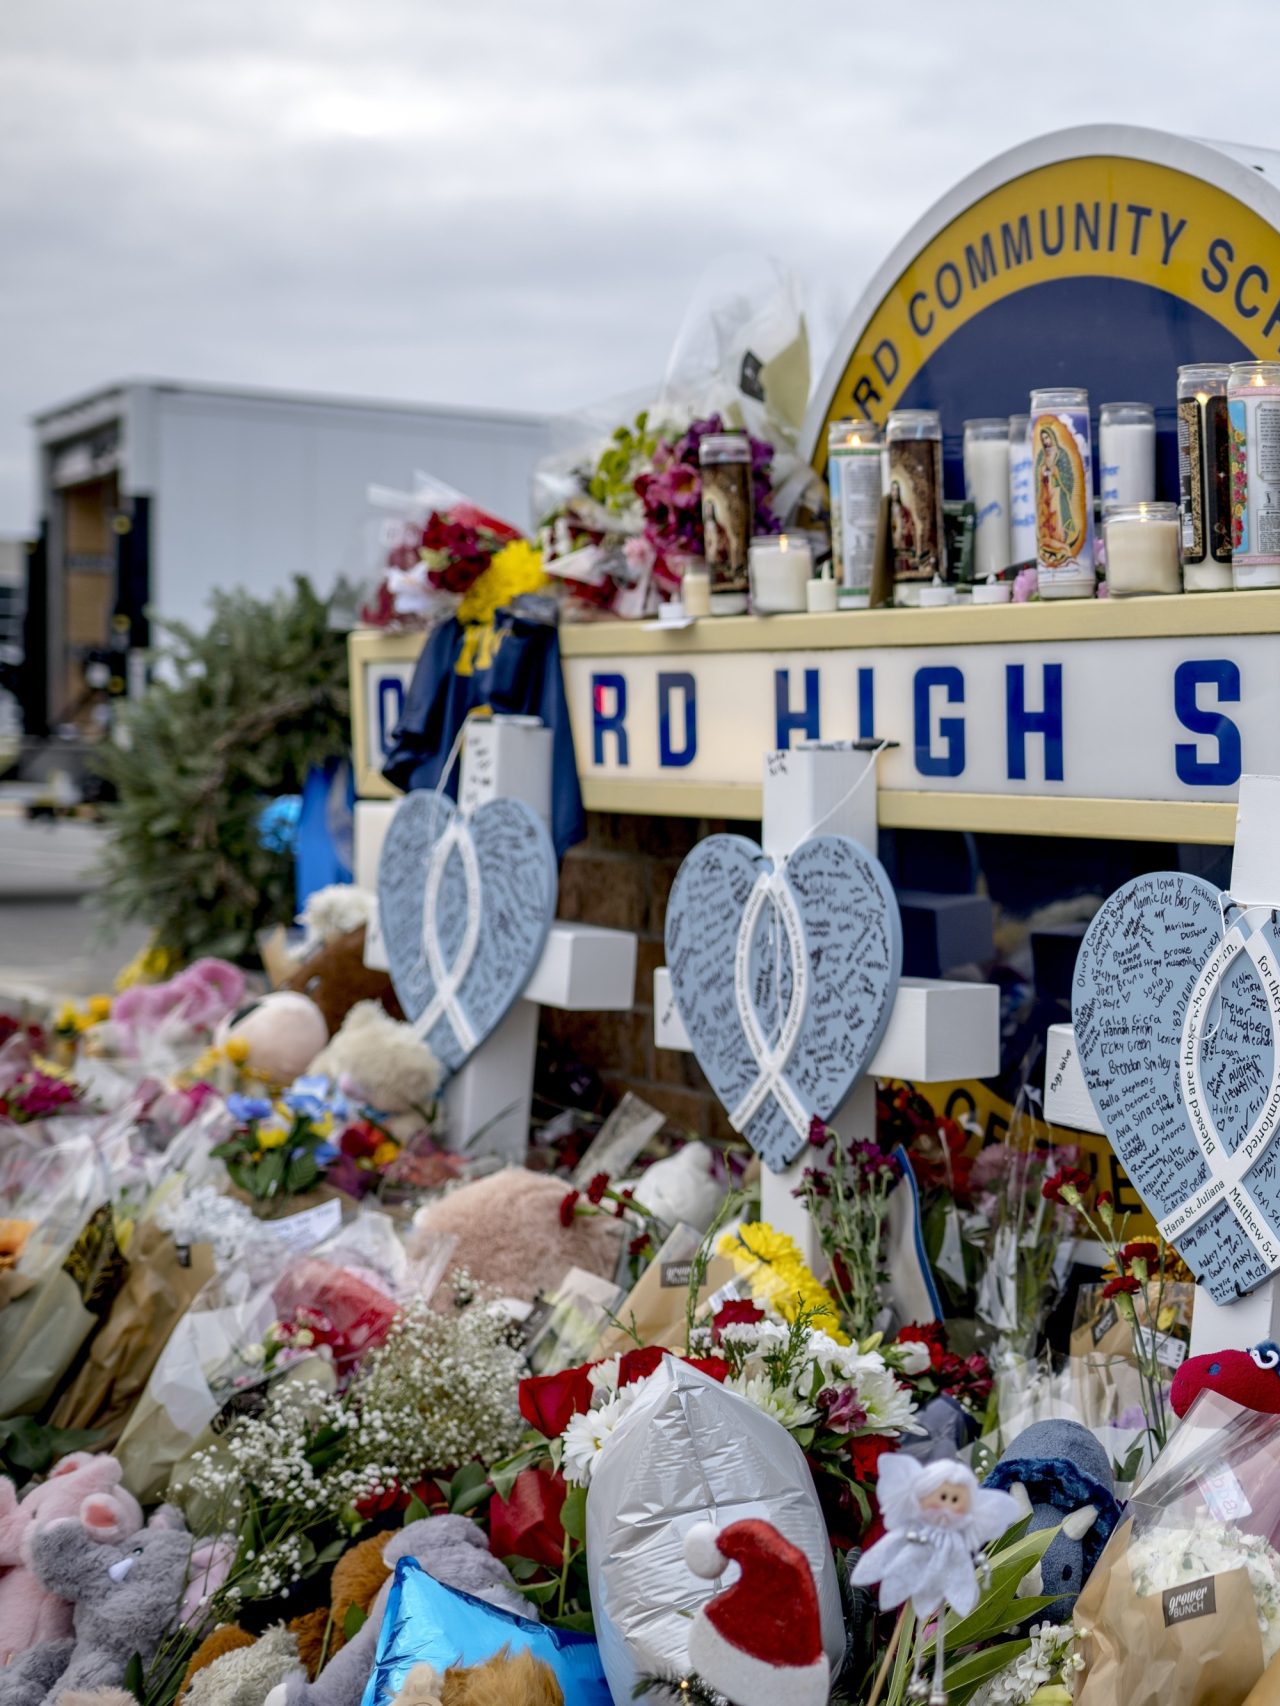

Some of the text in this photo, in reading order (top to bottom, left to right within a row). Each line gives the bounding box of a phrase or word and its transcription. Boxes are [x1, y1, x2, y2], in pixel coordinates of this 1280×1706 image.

[907, 202, 1188, 337] COMMUNITY
[774, 663, 1065, 781] HIGH
[1086, 901, 1114, 947] Cameron
[1163, 946, 1192, 959] Brooke
[1194, 931, 1221, 973] Dorsey
[1257, 955, 1272, 978] for
[1143, 979, 1163, 998] Sofia
[1152, 977, 1174, 1008] Jacob
[1221, 996, 1251, 1017] Trevor
[1103, 1025, 1130, 1038] Hannah
[1215, 1045, 1239, 1059] Logan
[1187, 1071, 1196, 1096] are
[1100, 1094, 1120, 1110] Bella
[1115, 1125, 1133, 1142] Ava
[1189, 1099, 1216, 1156] Blessed
[1163, 1179, 1225, 1237] Hana St. Juliana
[1229, 1186, 1279, 1264] Matthew 5:4
[1169, 1587, 1207, 1616] grower
[1174, 1601, 1204, 1618] BUNCH
